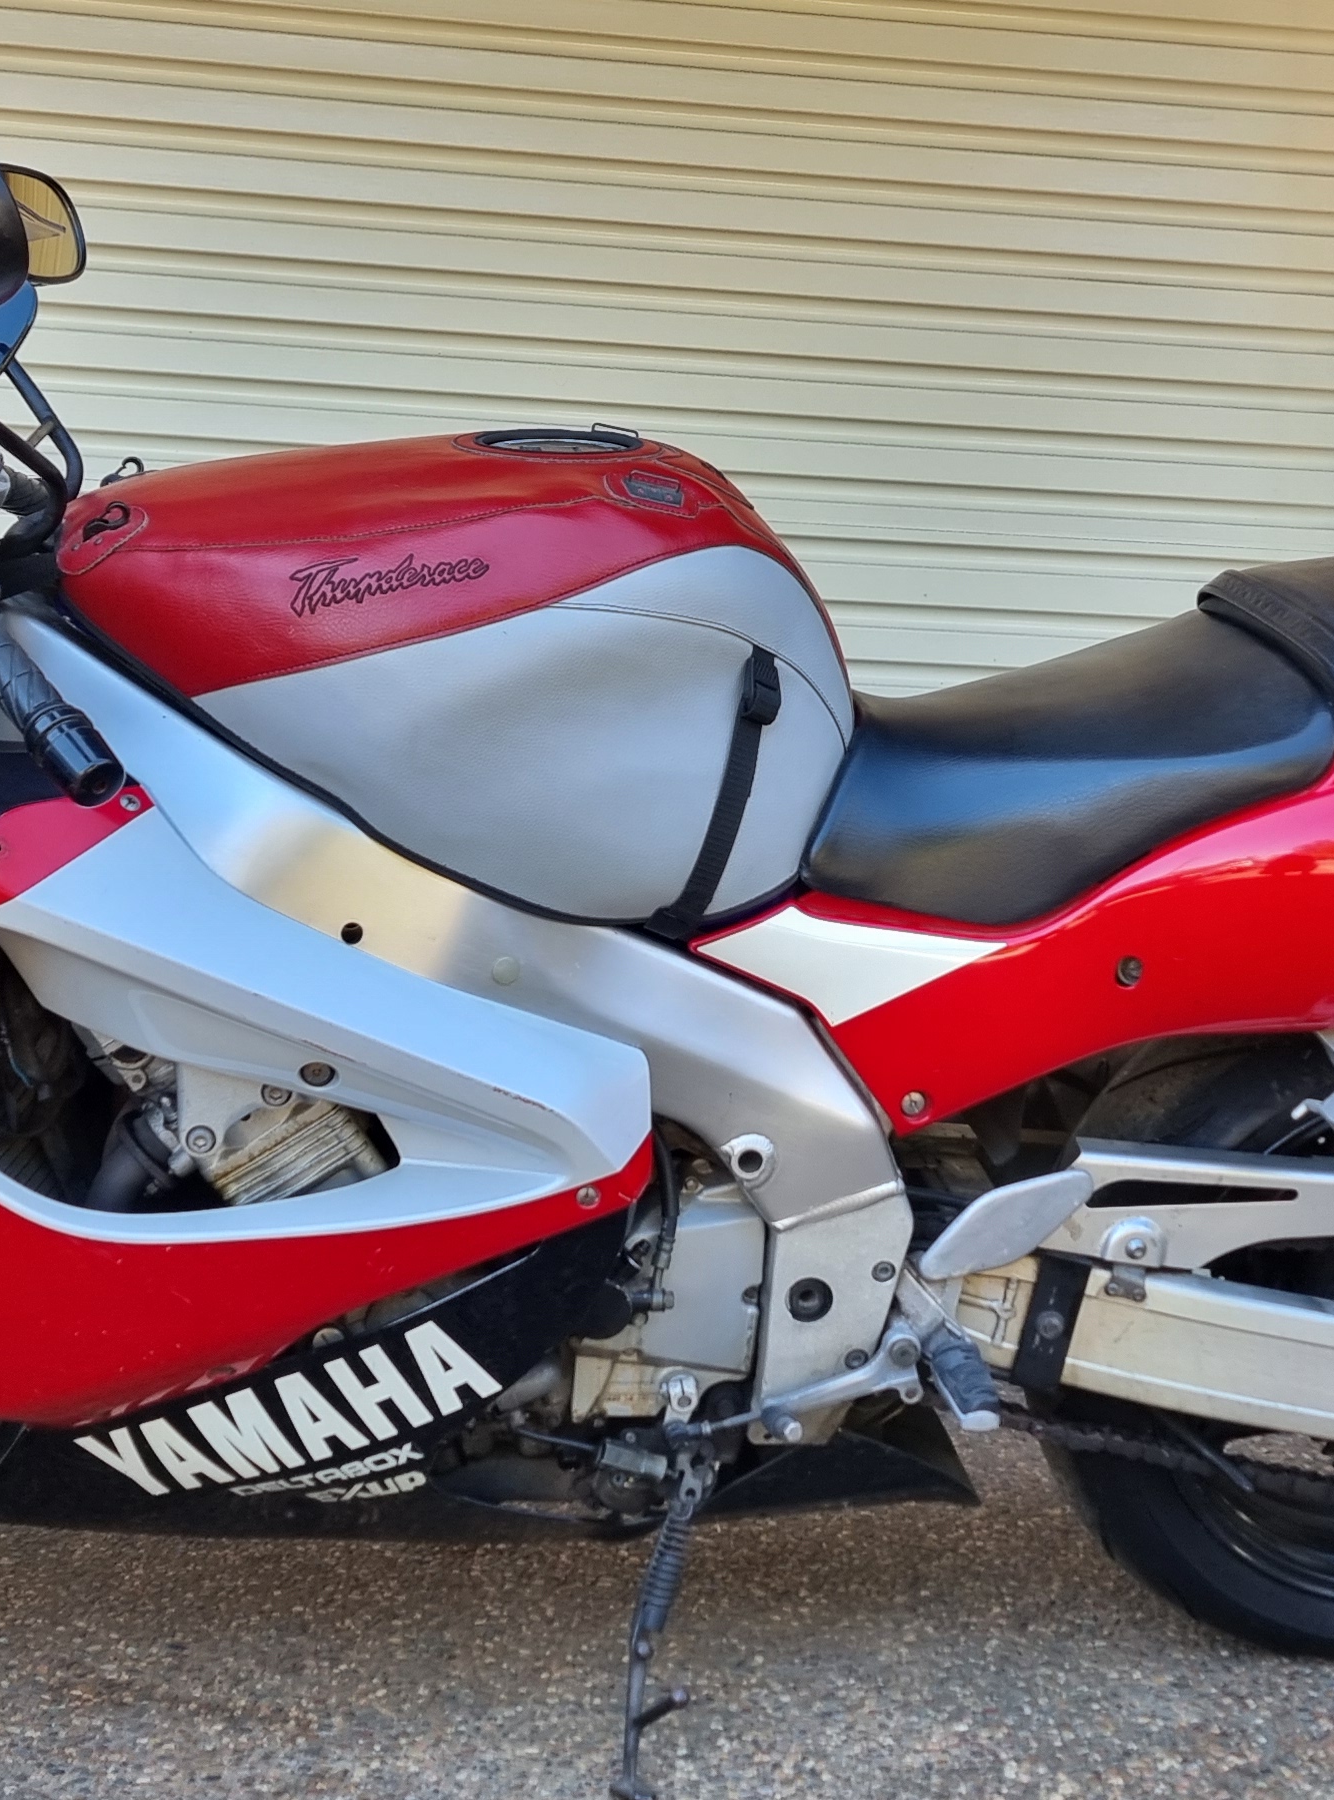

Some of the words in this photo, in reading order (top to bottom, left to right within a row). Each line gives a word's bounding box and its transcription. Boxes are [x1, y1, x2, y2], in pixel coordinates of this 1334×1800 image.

[289, 553, 490, 618] Thunderace
[73, 1320, 502, 1497] YAMAHA
[228, 1441, 425, 1497] DELTABOX
[304, 1470, 427, 1503] EXUP
